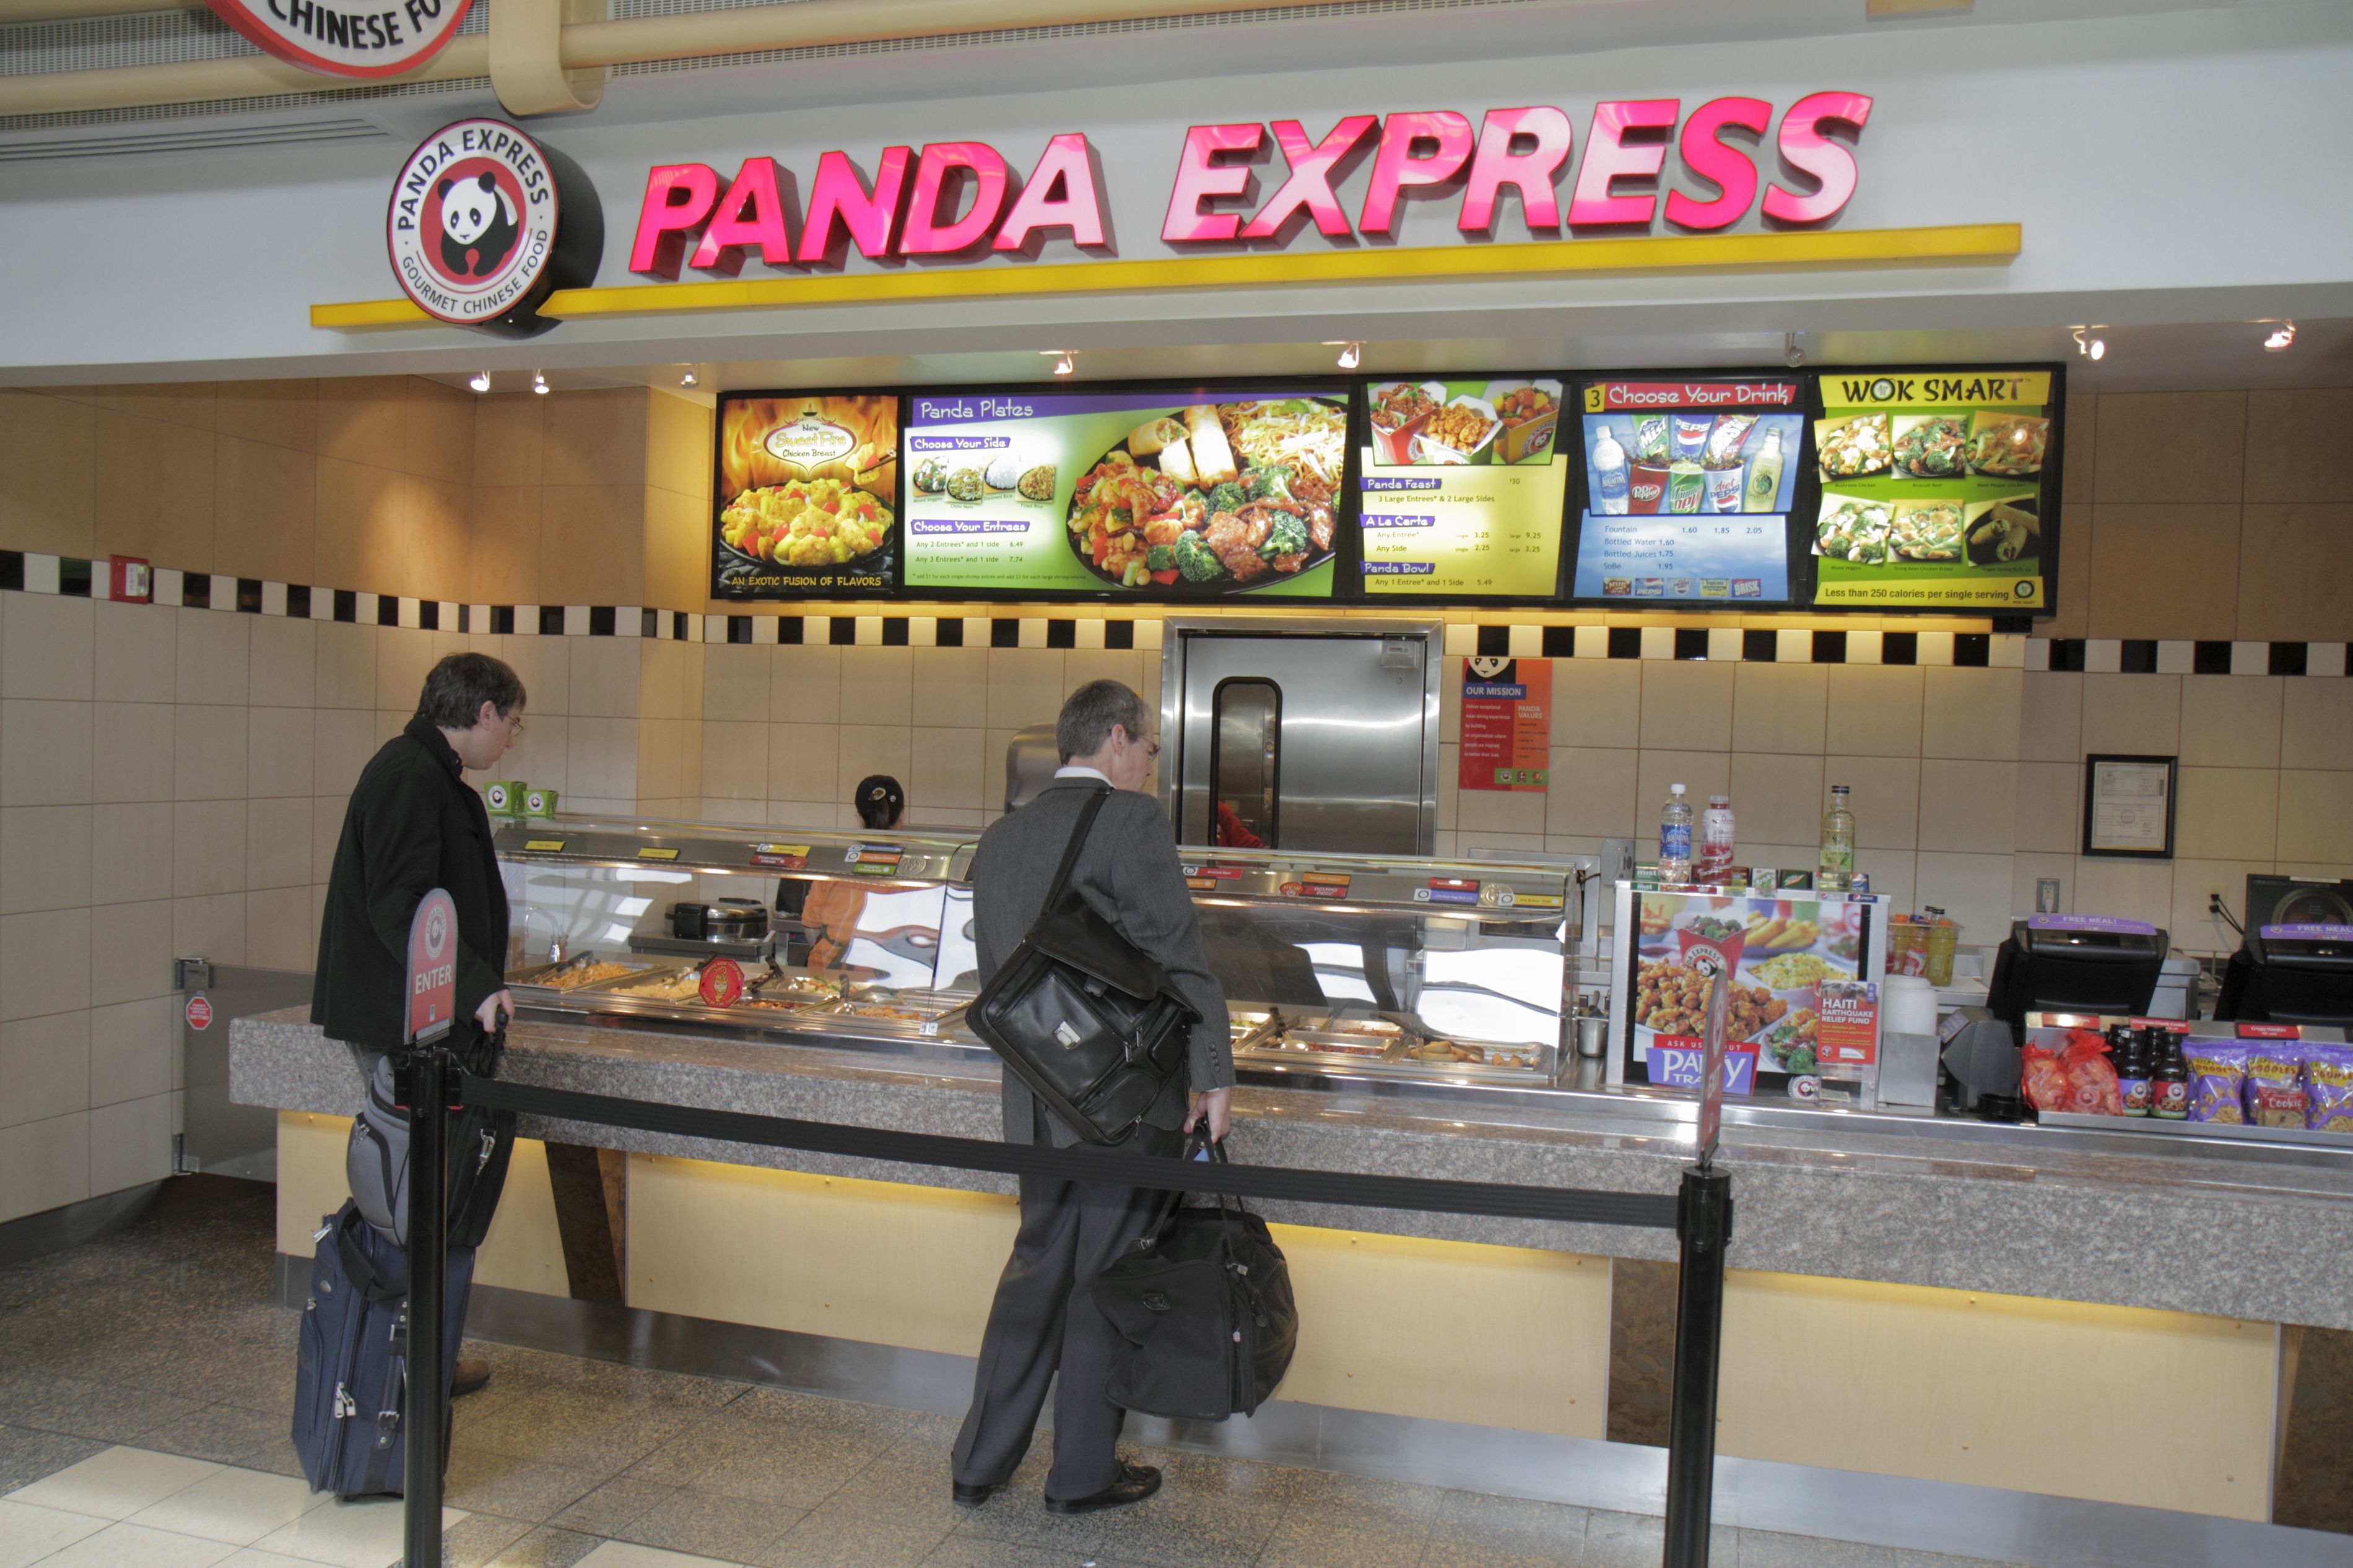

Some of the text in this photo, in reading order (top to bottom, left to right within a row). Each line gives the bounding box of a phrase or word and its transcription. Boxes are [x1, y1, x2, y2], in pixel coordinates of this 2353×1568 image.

[398, 129, 549, 230] PANDA EXPRESS
[629, 92, 1874, 273] PANDA EXPRESS
[402, 230, 548, 313] GOURMET CHINESE FOOD
[1609, 383, 1788, 405] Choose Your Drink
[1842, 378, 1915, 402] WOK
[1590, 390, 1600, 407] 3
[921, 399, 1033, 419] Panda Plates
[915, 437, 1006, 449] Choose Your Side
[812, 449, 835, 457] Breast
[1368, 479, 1402, 489] Panda
[1405, 478, 1436, 489] Feast
[1715, 478, 1735, 492] diet
[914, 520, 1025, 532] Choose Your Entrees
[1366, 516, 1428, 526] A La Carte
[1365, 563, 1429, 573] Panda Bowl
[731, 576, 881, 586] AN EXOTIC FUSION OF FLAVORS
[1734, 583, 1760, 596] BRISK
[1825, 588, 2009, 600] Less than 250 calories per single serving
[1466, 687, 1521, 696] OUR MISSION
[1691, 948, 1721, 962] EXPRESS
[415, 964, 451, 995] ENTER
[1822, 998, 1857, 1010] HAITI
[1822, 1009, 1873, 1018] EARTHQUAKE
[1707, 1063, 1721, 1099] EXIT
[2269, 1098, 2302, 1109] Cookie
